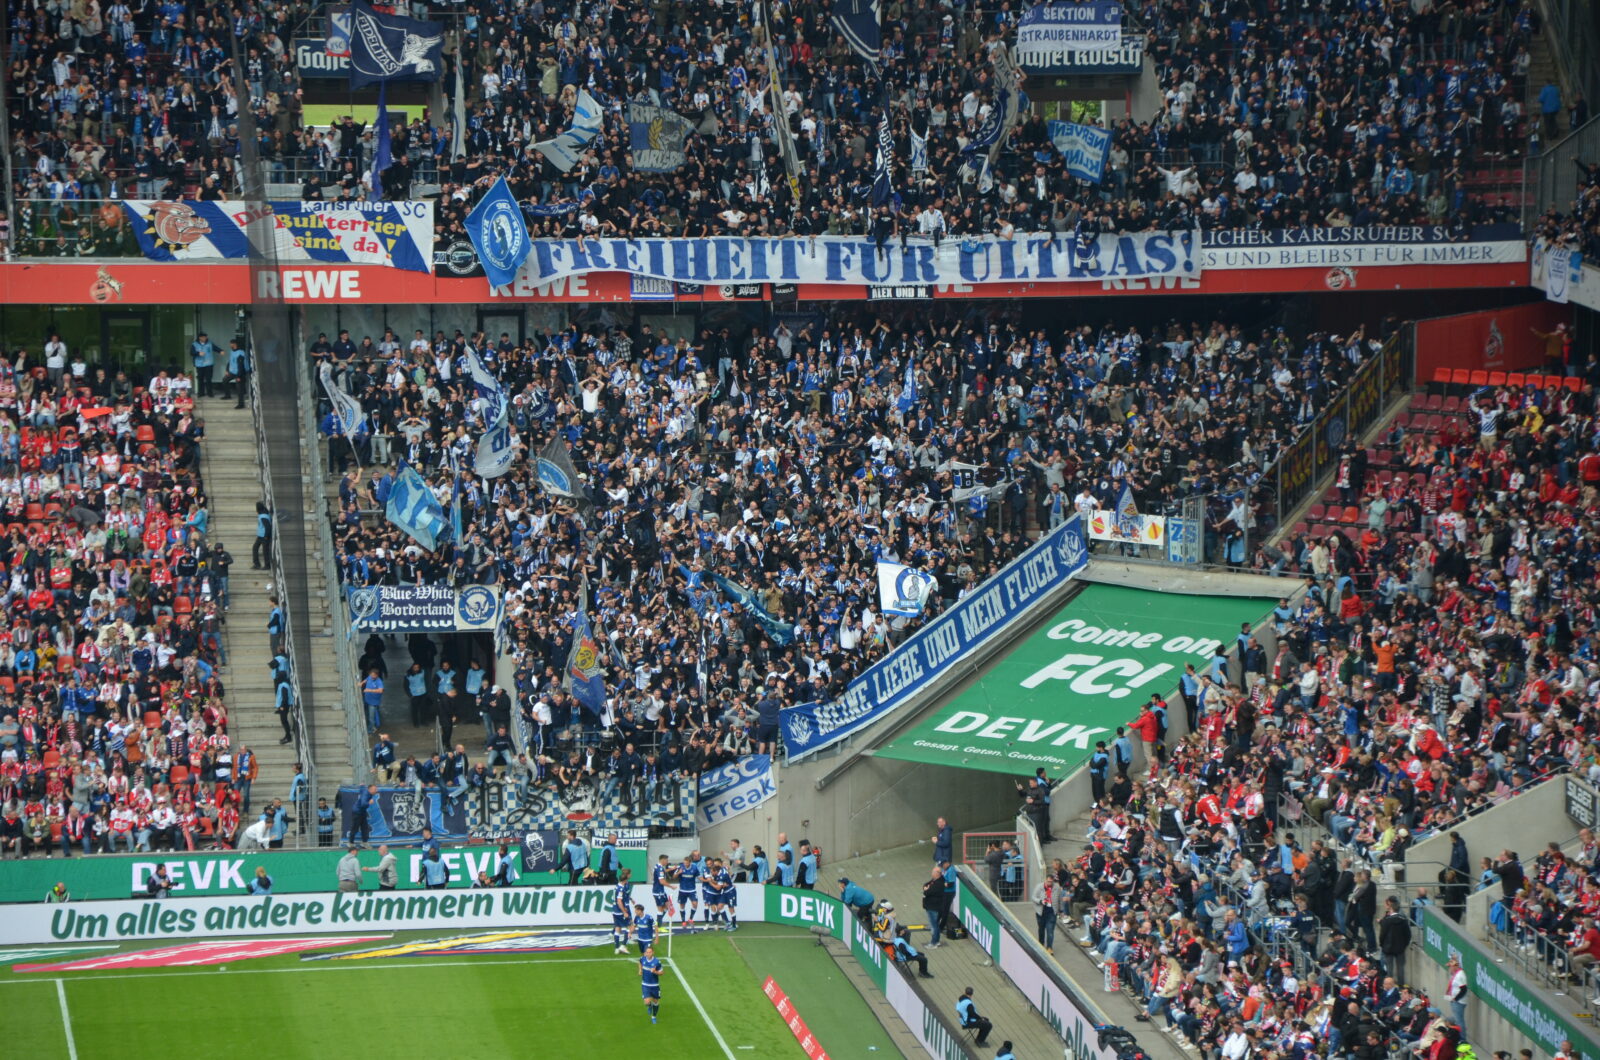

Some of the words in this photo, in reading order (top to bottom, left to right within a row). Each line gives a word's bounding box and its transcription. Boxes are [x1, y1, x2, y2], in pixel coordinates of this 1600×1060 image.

[1043, 7, 1096, 21] SEKTION
[358, 15, 397, 71] FIDELITAS
[1021, 29, 1118, 42] STRAUBENHARDT
[232, 204, 273, 227] Die
[402, 201, 426, 218] SC
[274, 214, 407, 237] Bullterrier
[1282, 226, 1425, 244] KARLSRUHER
[293, 231, 342, 251] sind
[353, 236, 378, 254] da
[533, 238, 806, 281] FREIHEIT
[1226, 251, 1271, 267] UND
[1280, 247, 1366, 265] BLEIBST
[1374, 244, 1413, 262] FÜR
[1424, 245, 1493, 262] IMMER
[258, 270, 361, 298] REWE
[633, 279, 673, 294] BADEN
[872, 287, 892, 298] ALEX
[895, 287, 915, 298] UND
[380, 585, 454, 602] Blue-White
[380, 602, 454, 617] Borderland
[872, 644, 924, 704] LIEBE
[923, 618, 961, 669] UND
[959, 584, 1007, 643] MEIN
[1004, 545, 1059, 611] FLUCH
[1046, 619, 1163, 649] Come
[1019, 653, 1175, 699] FC!
[934, 711, 1111, 750] DEVK
[912, 740, 959, 752] Gesagt.
[963, 746, 1003, 757] Getan.
[1007, 751, 1067, 765] Geholfen.
[703, 778, 777, 824] Freak
[593, 827, 649, 838] WESTSIDE
[132, 859, 247, 891] DEVK
[51, 908, 109, 940] Um
[115, 902, 197, 936] alles
[204, 896, 325, 930] andere
[331, 890, 495, 923] kümmern
[502, 886, 556, 916] wir
[781, 893, 834, 929] DEVK
